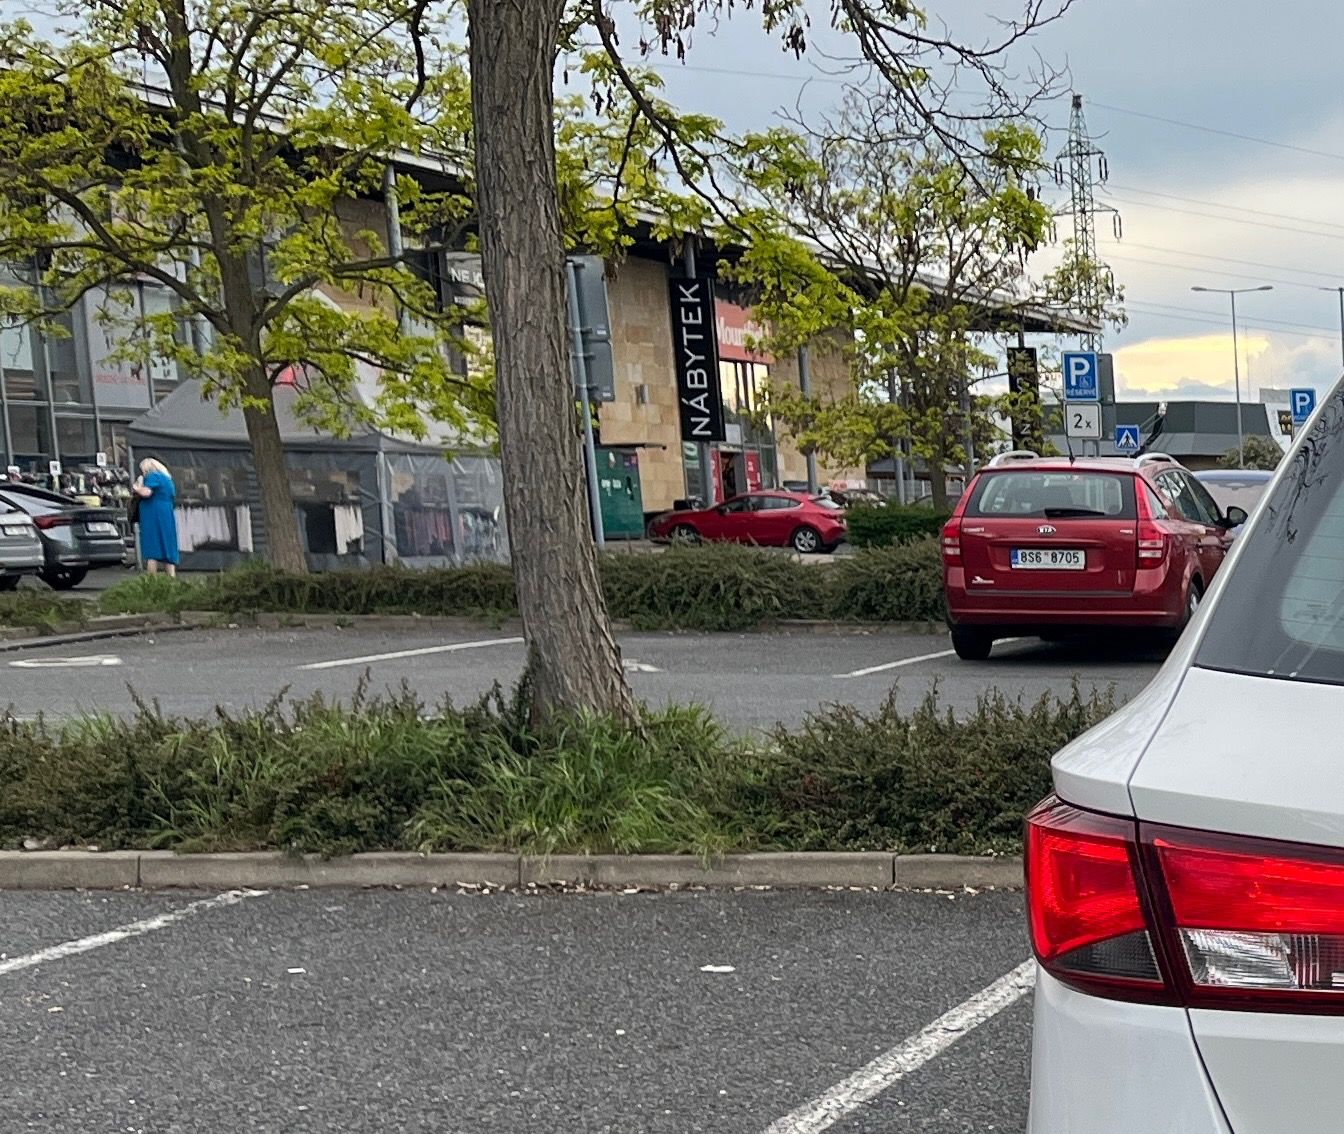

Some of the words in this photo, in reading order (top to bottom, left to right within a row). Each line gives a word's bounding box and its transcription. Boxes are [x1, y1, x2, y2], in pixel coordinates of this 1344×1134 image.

[679, 283, 712, 436] NÁBYTEK
[1069, 357, 1090, 386] P
[1295, 392, 1311, 414] P
[1020, 551, 1042, 564] 8S6
[1050, 551, 1080, 564] 8705
